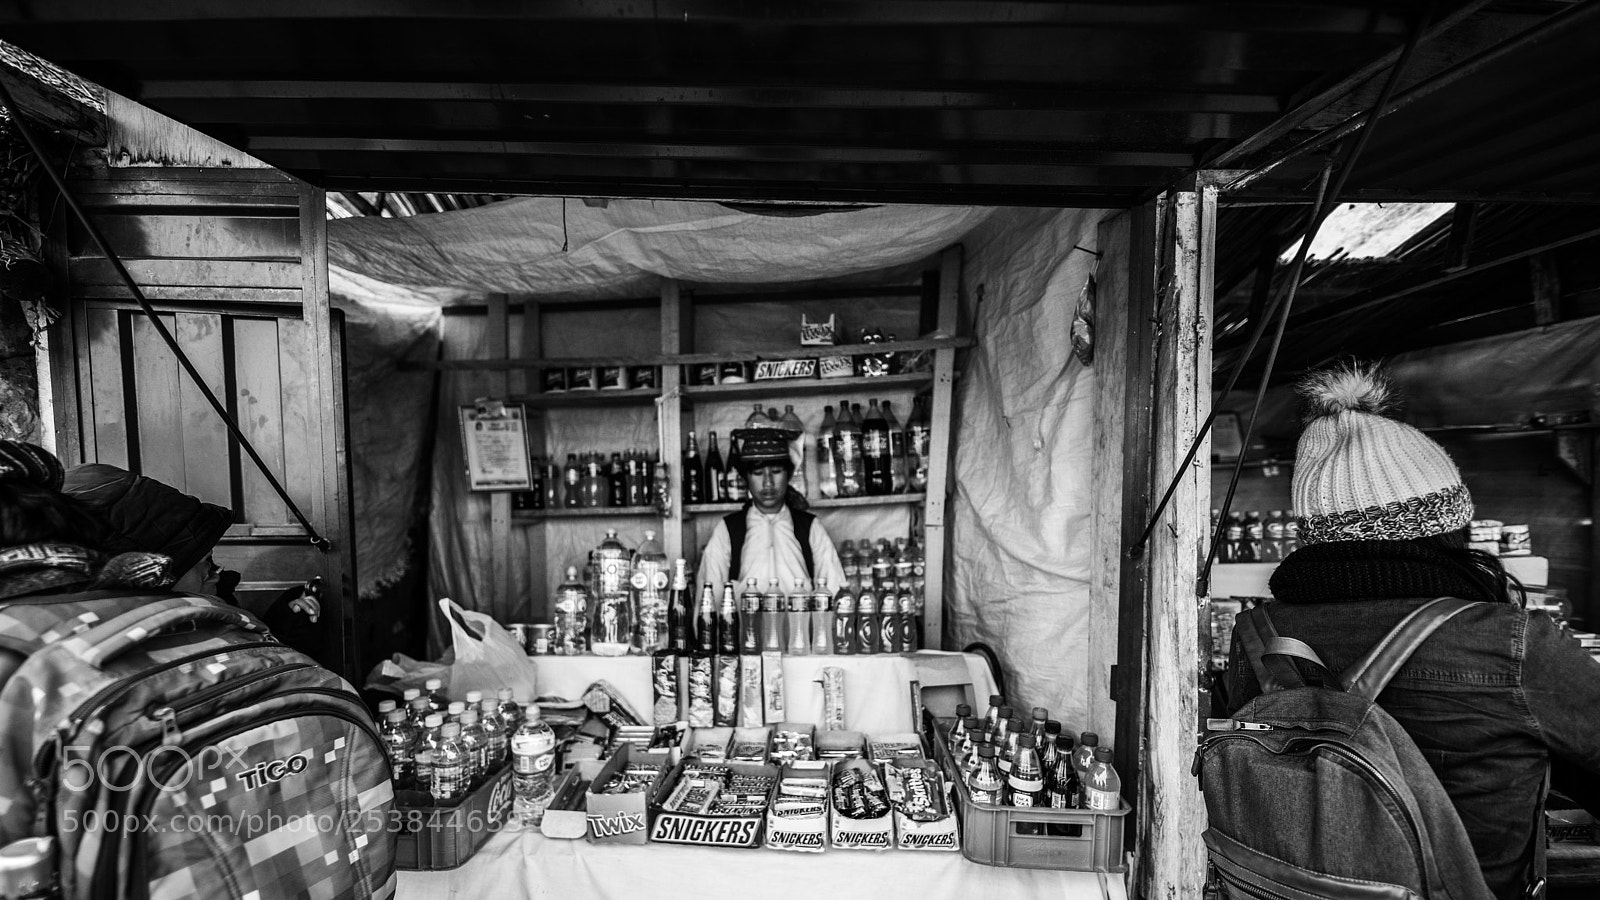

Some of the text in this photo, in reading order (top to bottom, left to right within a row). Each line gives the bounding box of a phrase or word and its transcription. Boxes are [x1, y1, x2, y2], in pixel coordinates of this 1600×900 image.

[757, 360, 815, 378] SNICKERS
[587, 811, 645, 838] Twix
[656, 816, 756, 844] SNICKERS
[771, 831, 823, 846] SNICKERS
[836, 831, 889, 845] SNICKERS
[903, 832, 955, 846] SNICKERS
